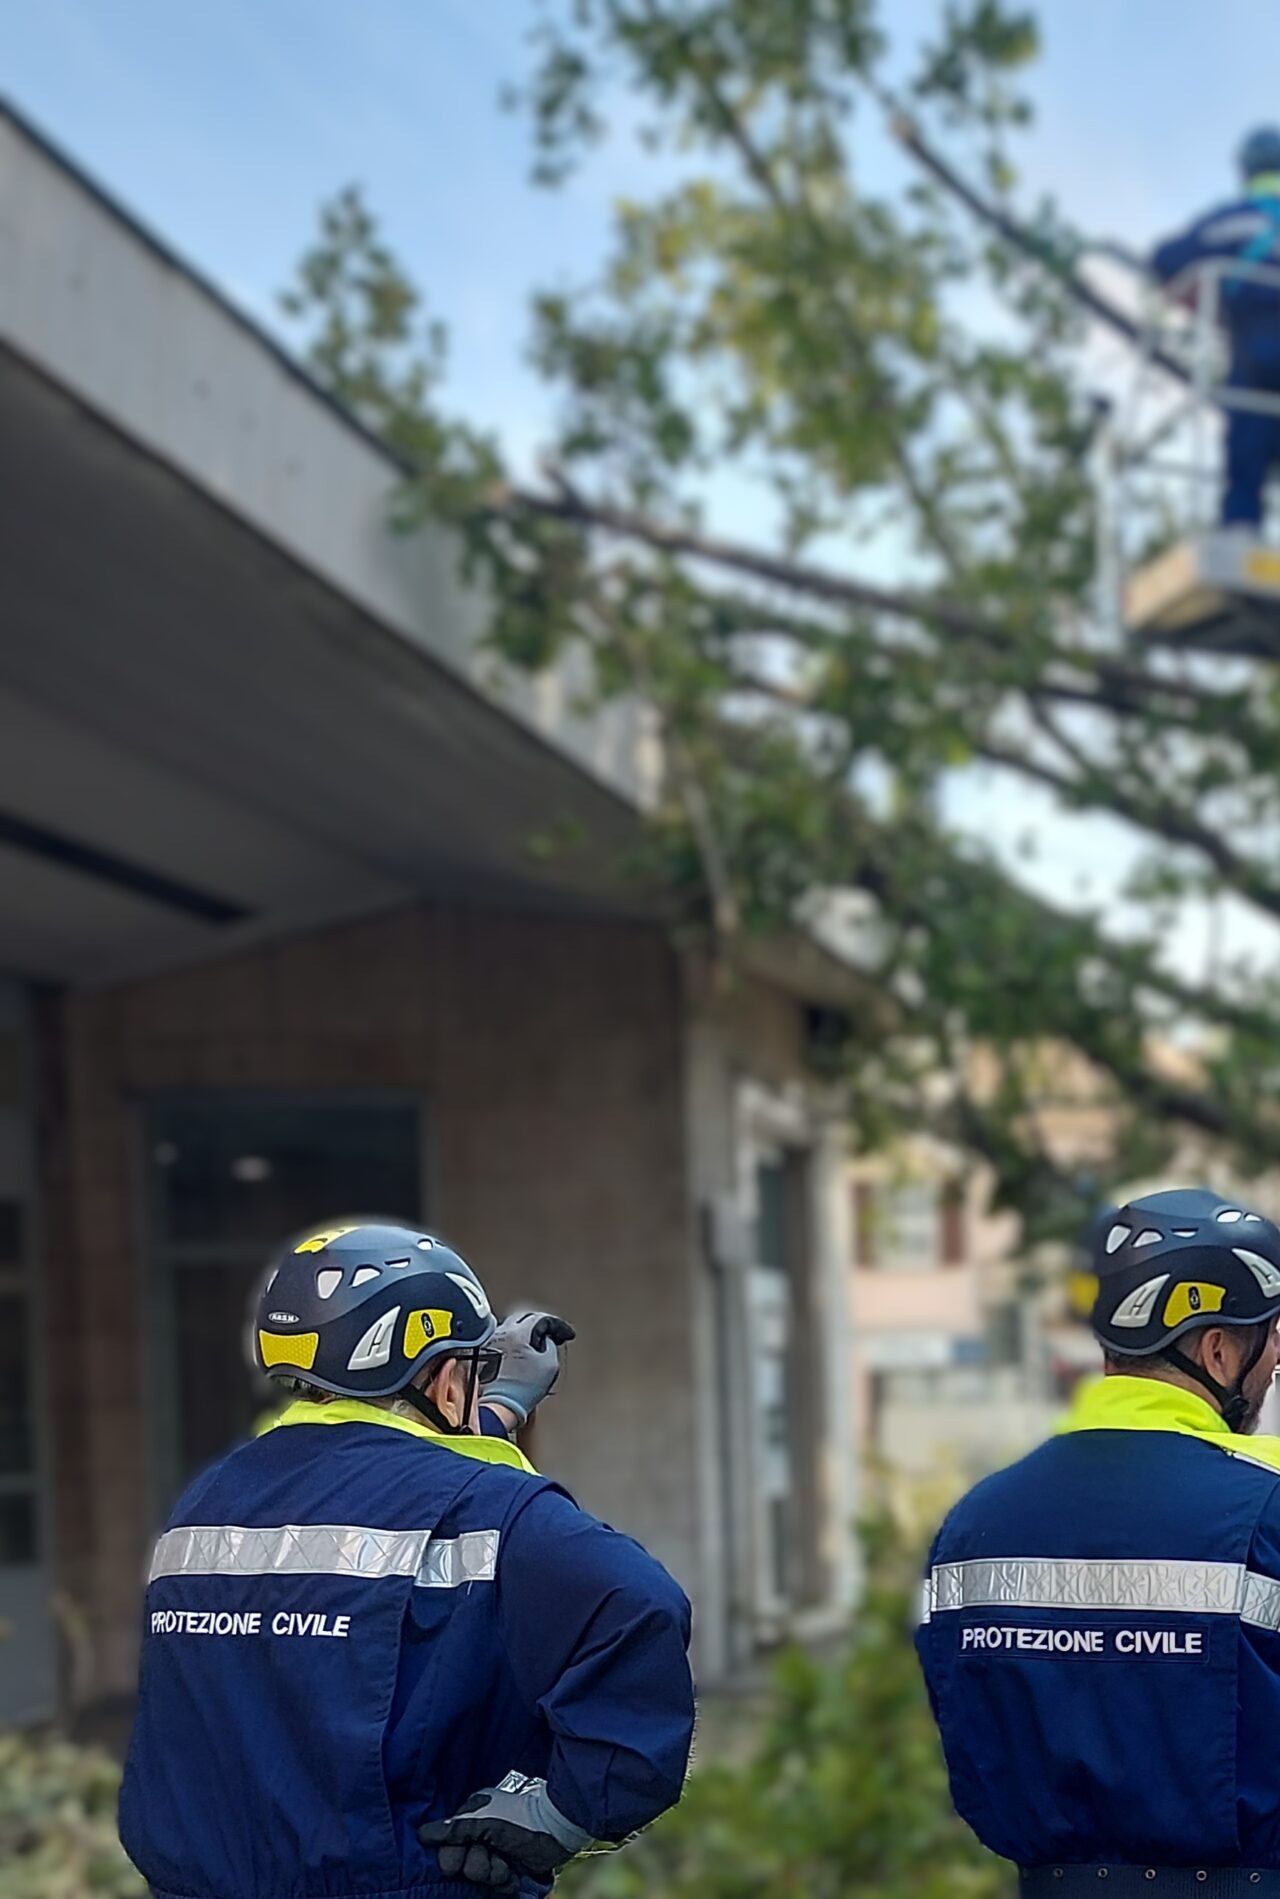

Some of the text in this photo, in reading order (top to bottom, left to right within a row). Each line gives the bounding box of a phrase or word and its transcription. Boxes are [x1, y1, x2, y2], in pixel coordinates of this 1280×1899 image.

[151, 1610, 351, 1637] PROTEZIONE CIVILE
[961, 1626, 1202, 1654] PROTEZIONE CIVILE
